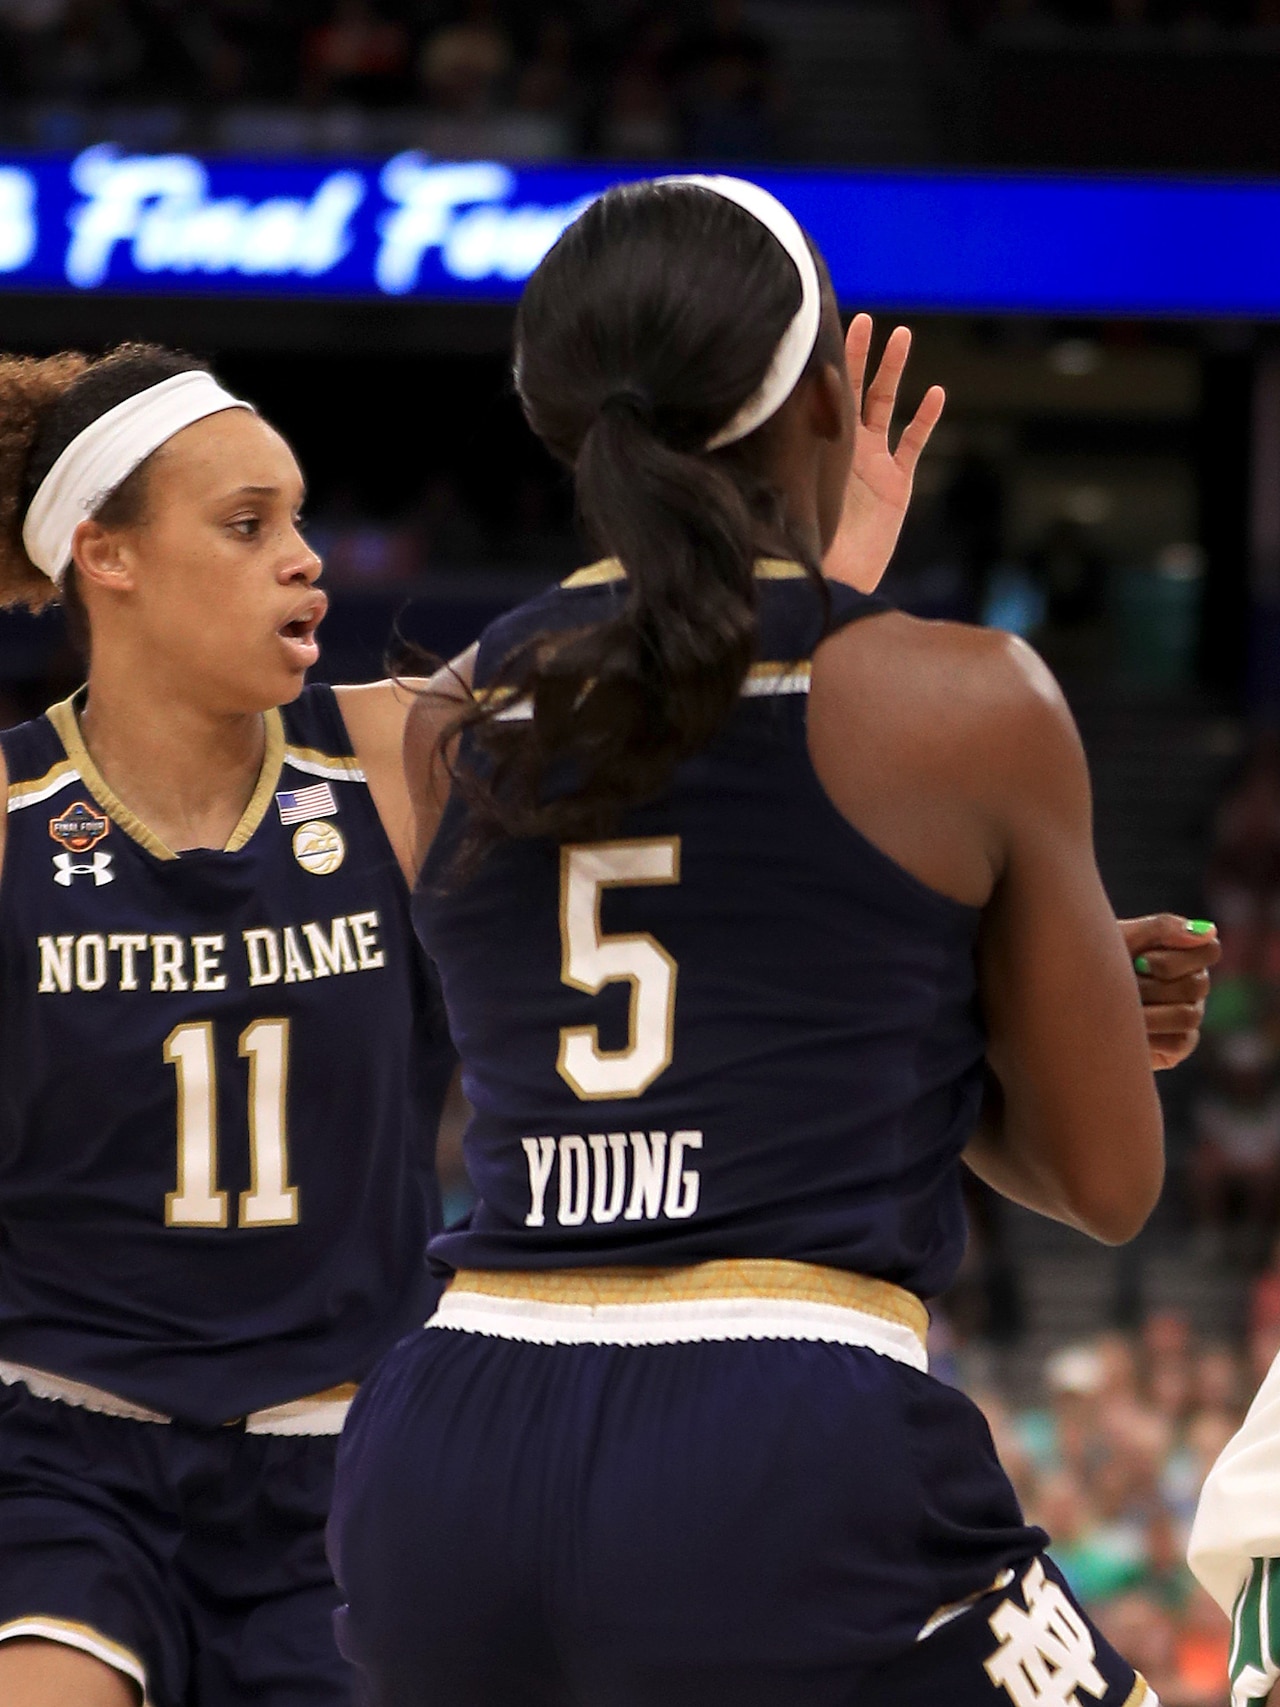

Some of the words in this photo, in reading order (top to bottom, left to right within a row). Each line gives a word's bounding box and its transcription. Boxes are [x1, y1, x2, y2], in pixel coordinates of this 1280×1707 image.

[66, 145, 365, 288] Final
[376, 151, 604, 294] Fou
[37, 933, 227, 993] NOTRE
[242, 910, 386, 987] DAME
[556, 834, 681, 1100] 5
[163, 1018, 299, 1228] 11
[521, 1130, 703, 1228] YOUNG
